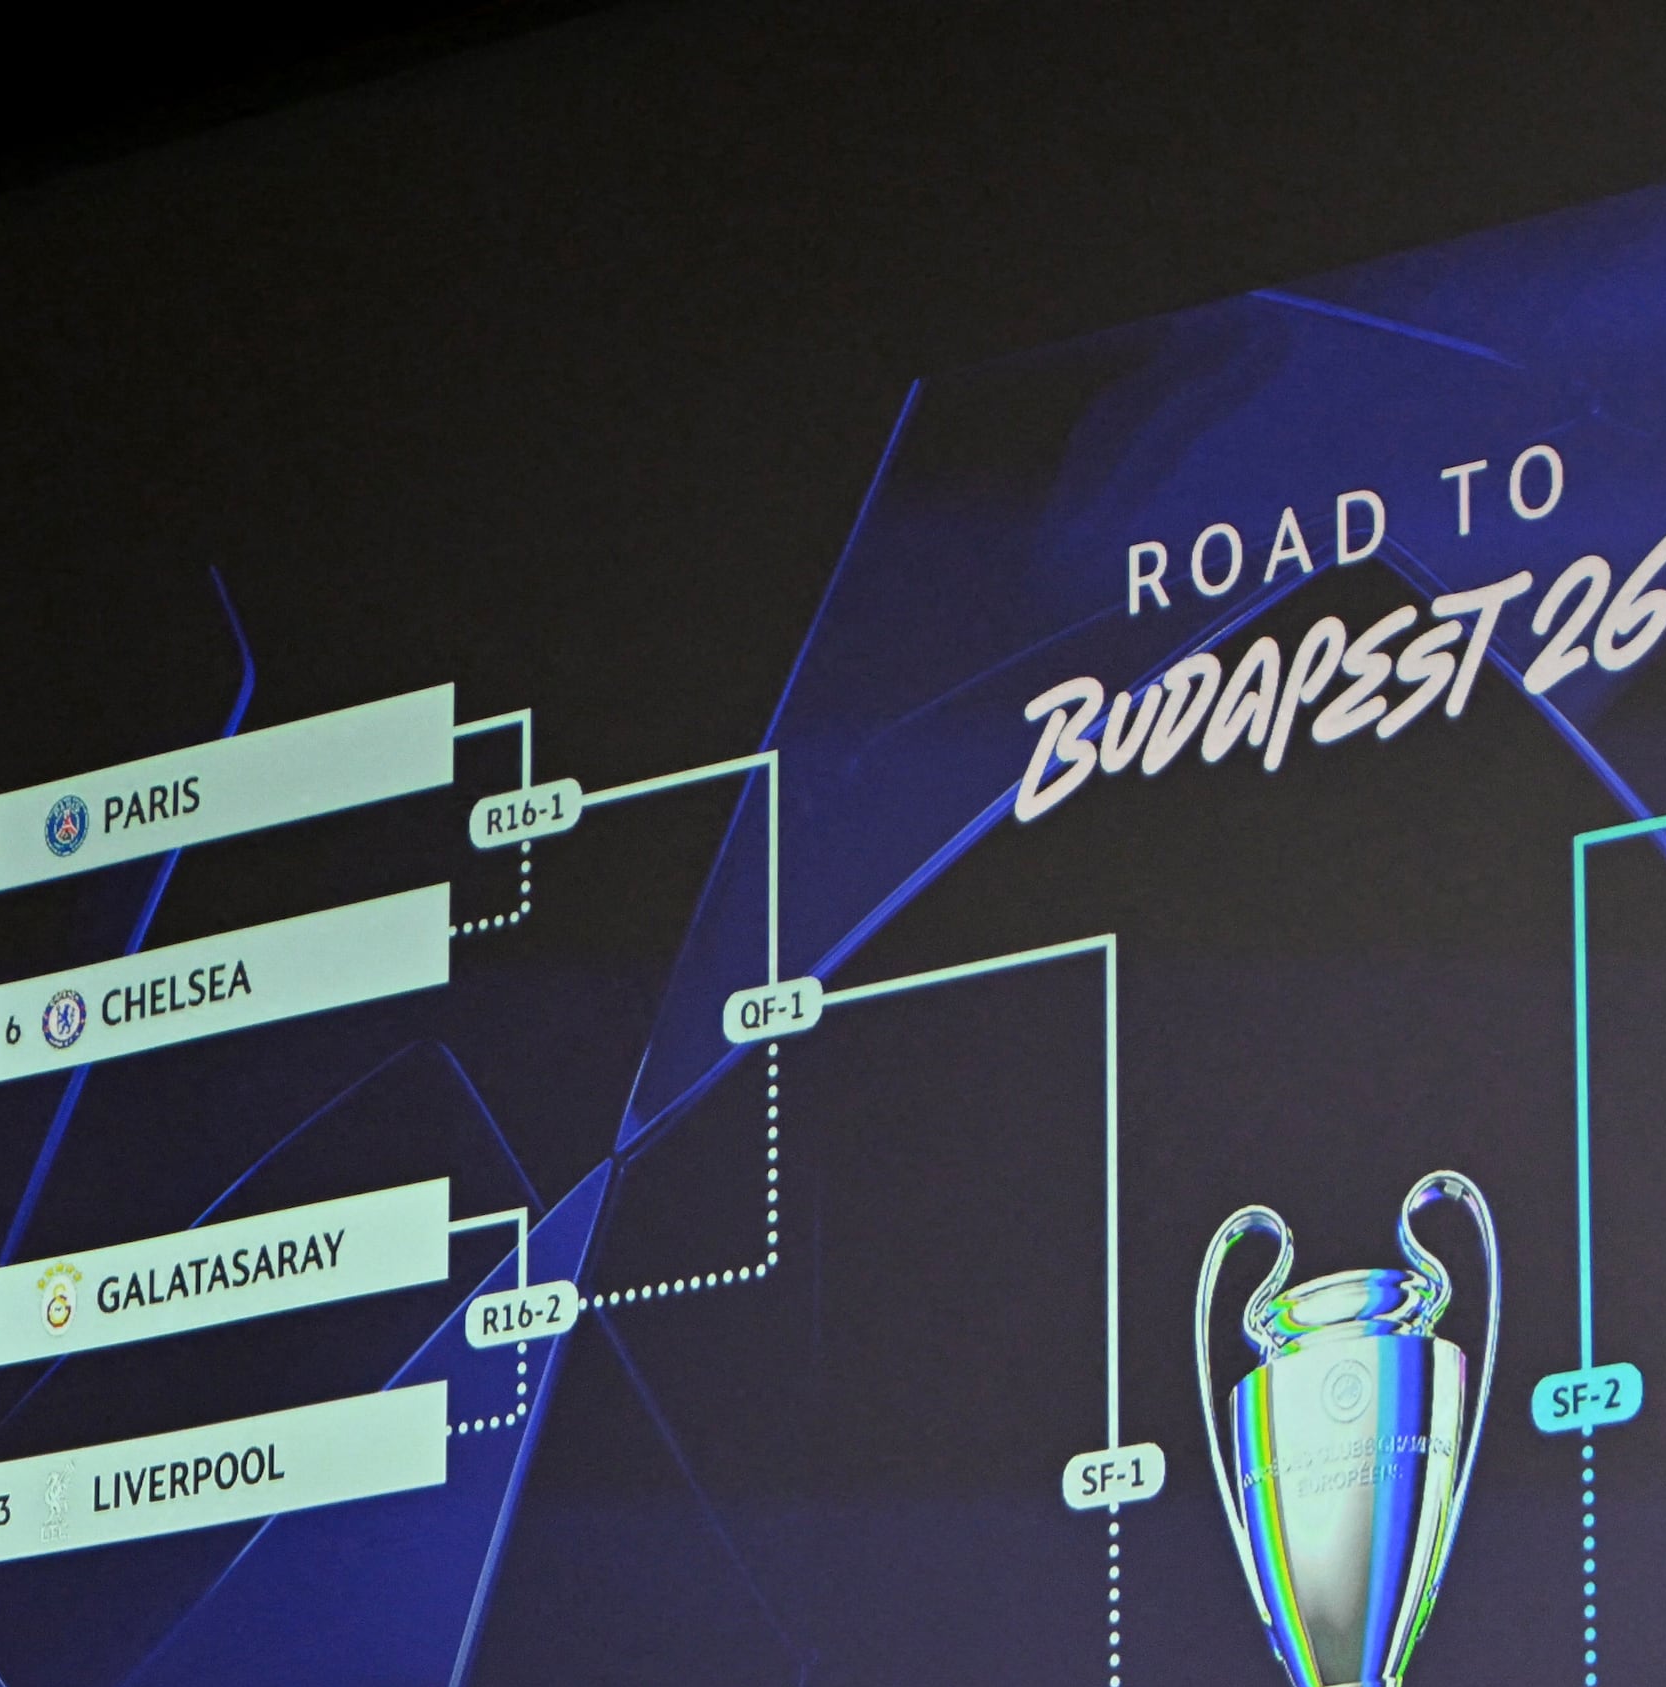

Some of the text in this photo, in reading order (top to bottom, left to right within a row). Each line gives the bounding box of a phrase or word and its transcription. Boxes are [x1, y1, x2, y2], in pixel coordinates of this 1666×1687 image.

[1128, 445, 1564, 615] ROAD TO
[1015, 570, 1533, 823] BUDAPEST
[104, 776, 200, 834] PARIS
[486, 792, 565, 836] R16-1
[5, 1015, 22, 1045] 6
[101, 960, 252, 1026] CHELSEA
[740, 991, 804, 1030] QF-1
[97, 1229, 345, 1314] GALATASARAY
[483, 1294, 561, 1336] R16-2
[1552, 1378, 1621, 1418] SF-2
[93, 1444, 285, 1512] LIVERPOOL
[1082, 1458, 1145, 1496] SF-1
